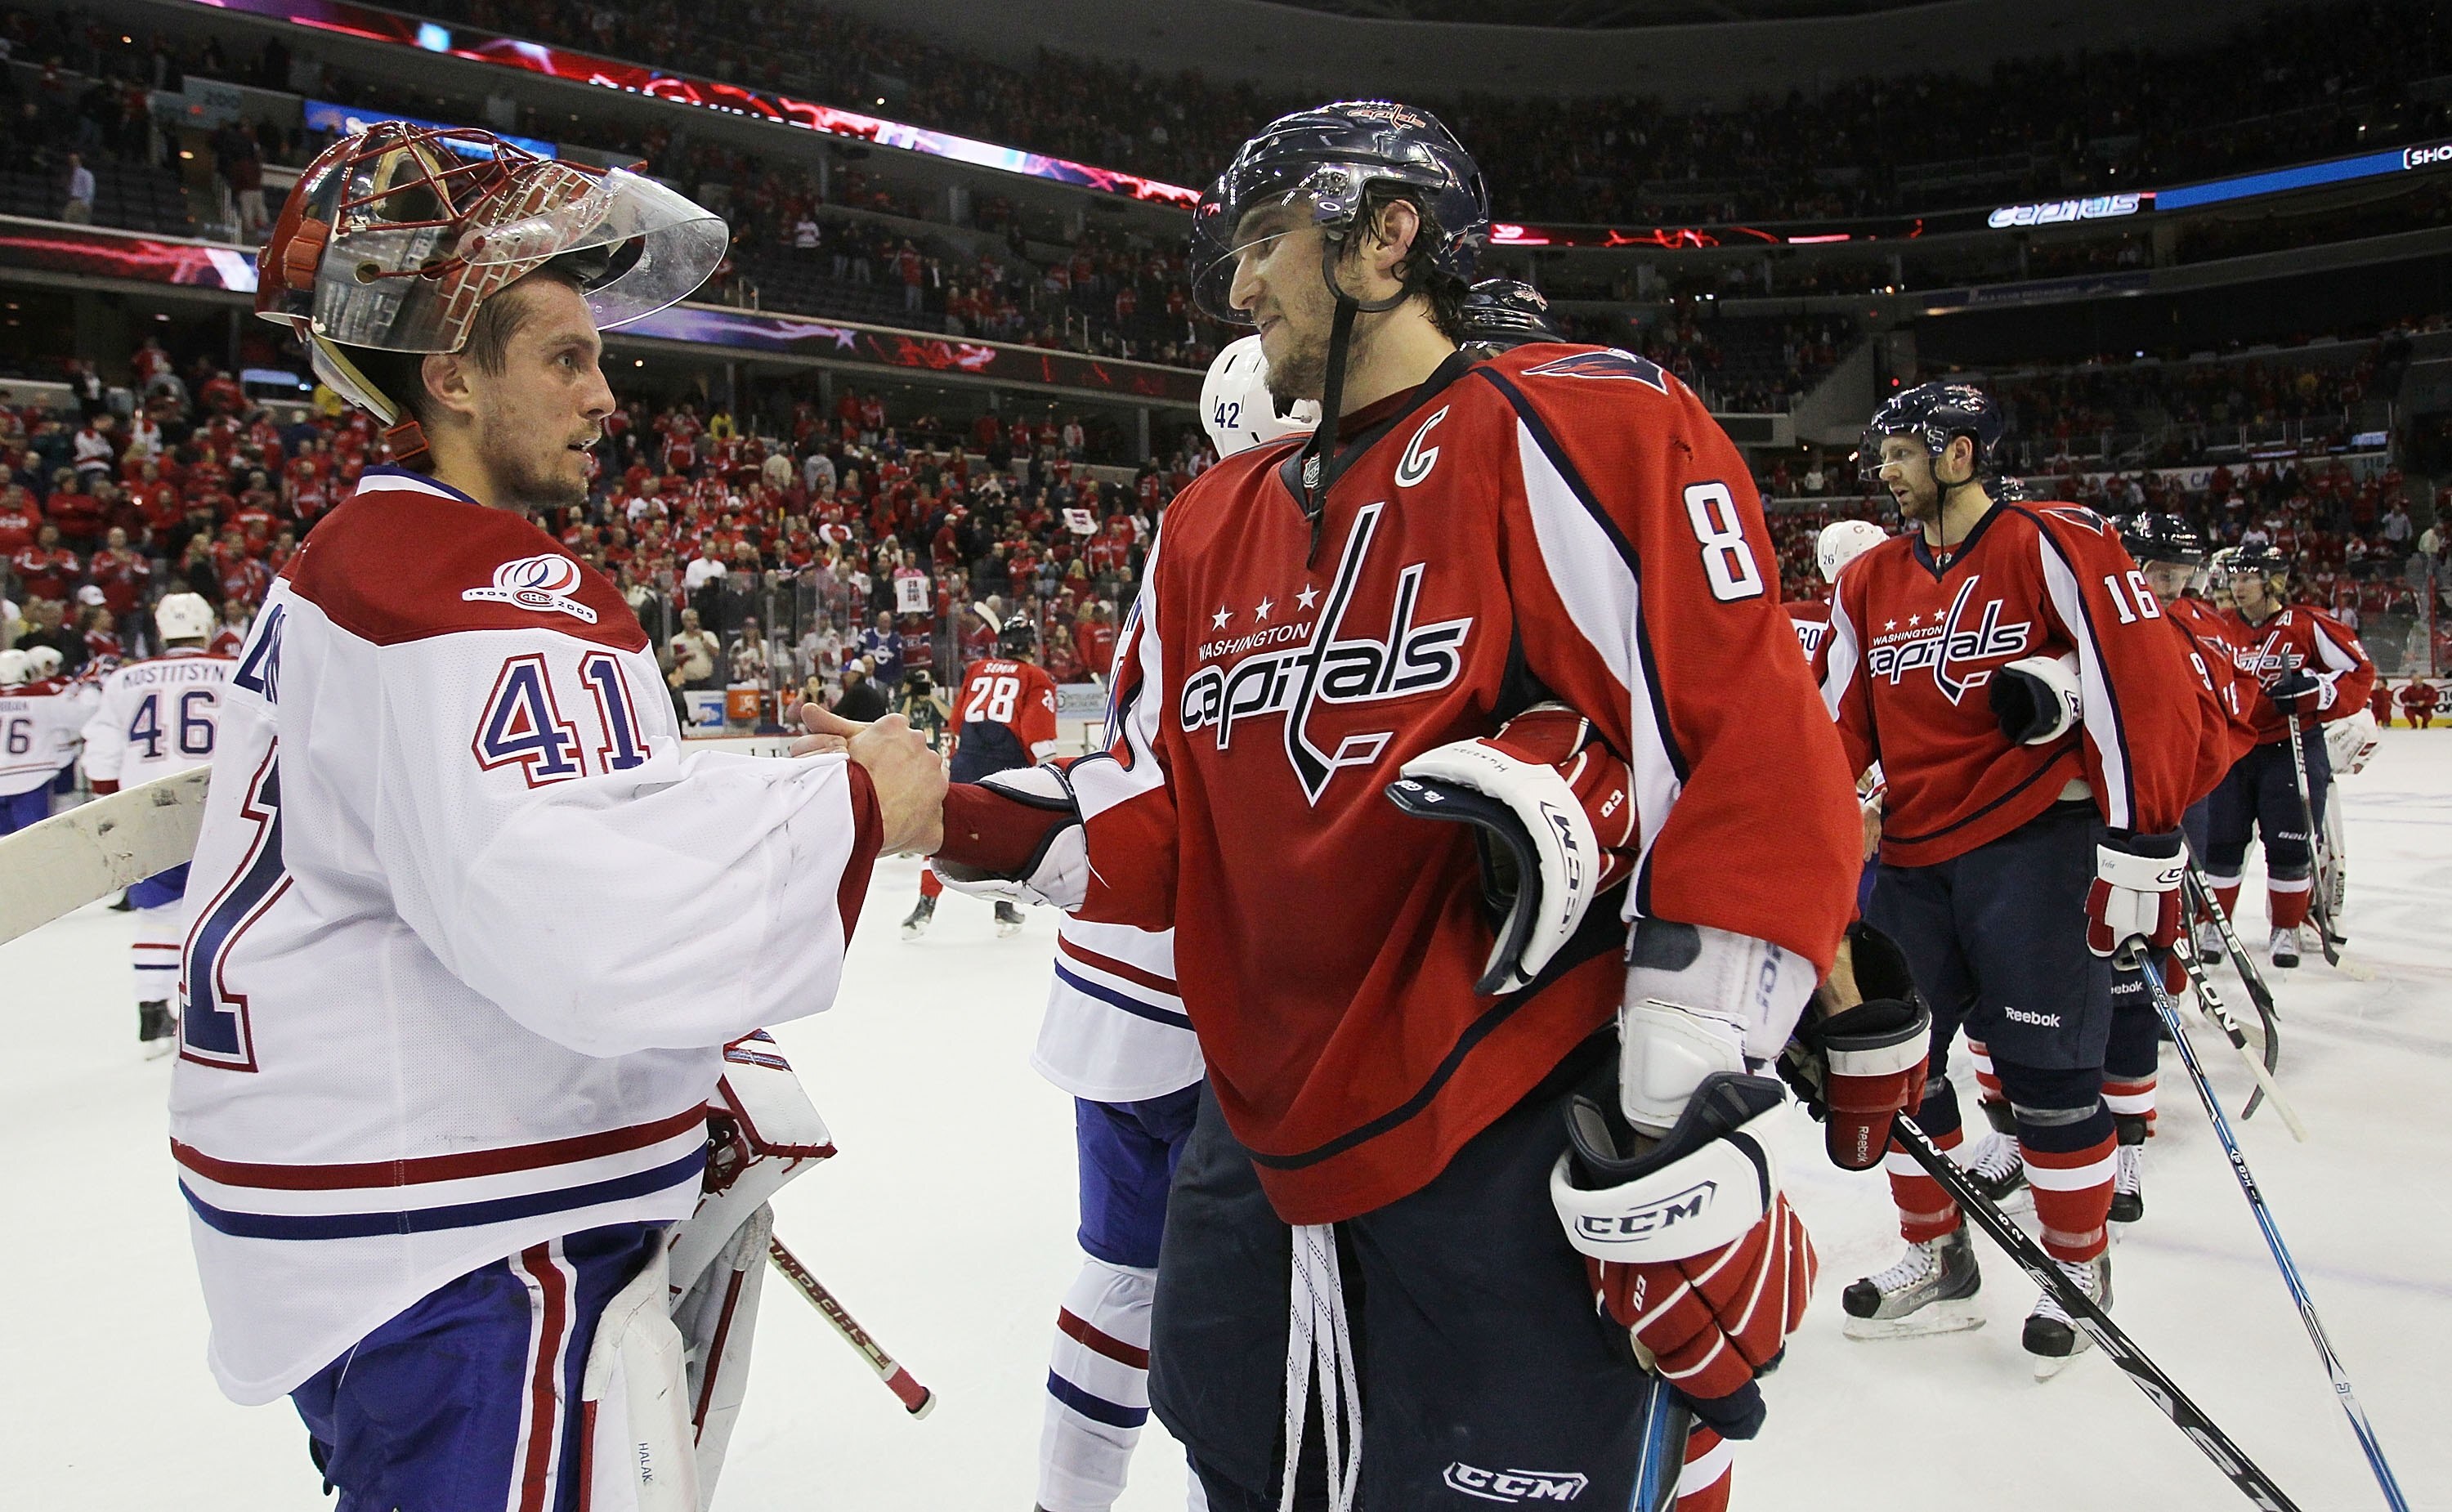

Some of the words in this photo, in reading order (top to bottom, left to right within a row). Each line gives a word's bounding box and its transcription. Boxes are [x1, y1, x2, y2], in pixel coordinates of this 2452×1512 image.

[1215, 402, 1239, 428] 42
[1394, 405, 1450, 488] C
[1682, 479, 1765, 604] 8
[557, 601, 594, 620] 2009
[2104, 570, 2161, 625] 16
[1873, 625, 1943, 646] WASHINGTON
[2275, 611, 2292, 626] A
[1181, 502, 1473, 808] capitals
[1199, 622, 1311, 662] WASHINGTON
[124, 665, 226, 689] KOSTITSYN
[472, 651, 651, 789] 41
[964, 677, 1020, 723] 28
[129, 689, 216, 758] 46
[2004, 1006, 2061, 1028] Reebok
[1856, 1125, 1869, 1163] Reebok
[1582, 1194, 1704, 1234] CCM
[638, 1443, 653, 1483] HALAK
[1455, 1462, 1574, 1501] CCM
